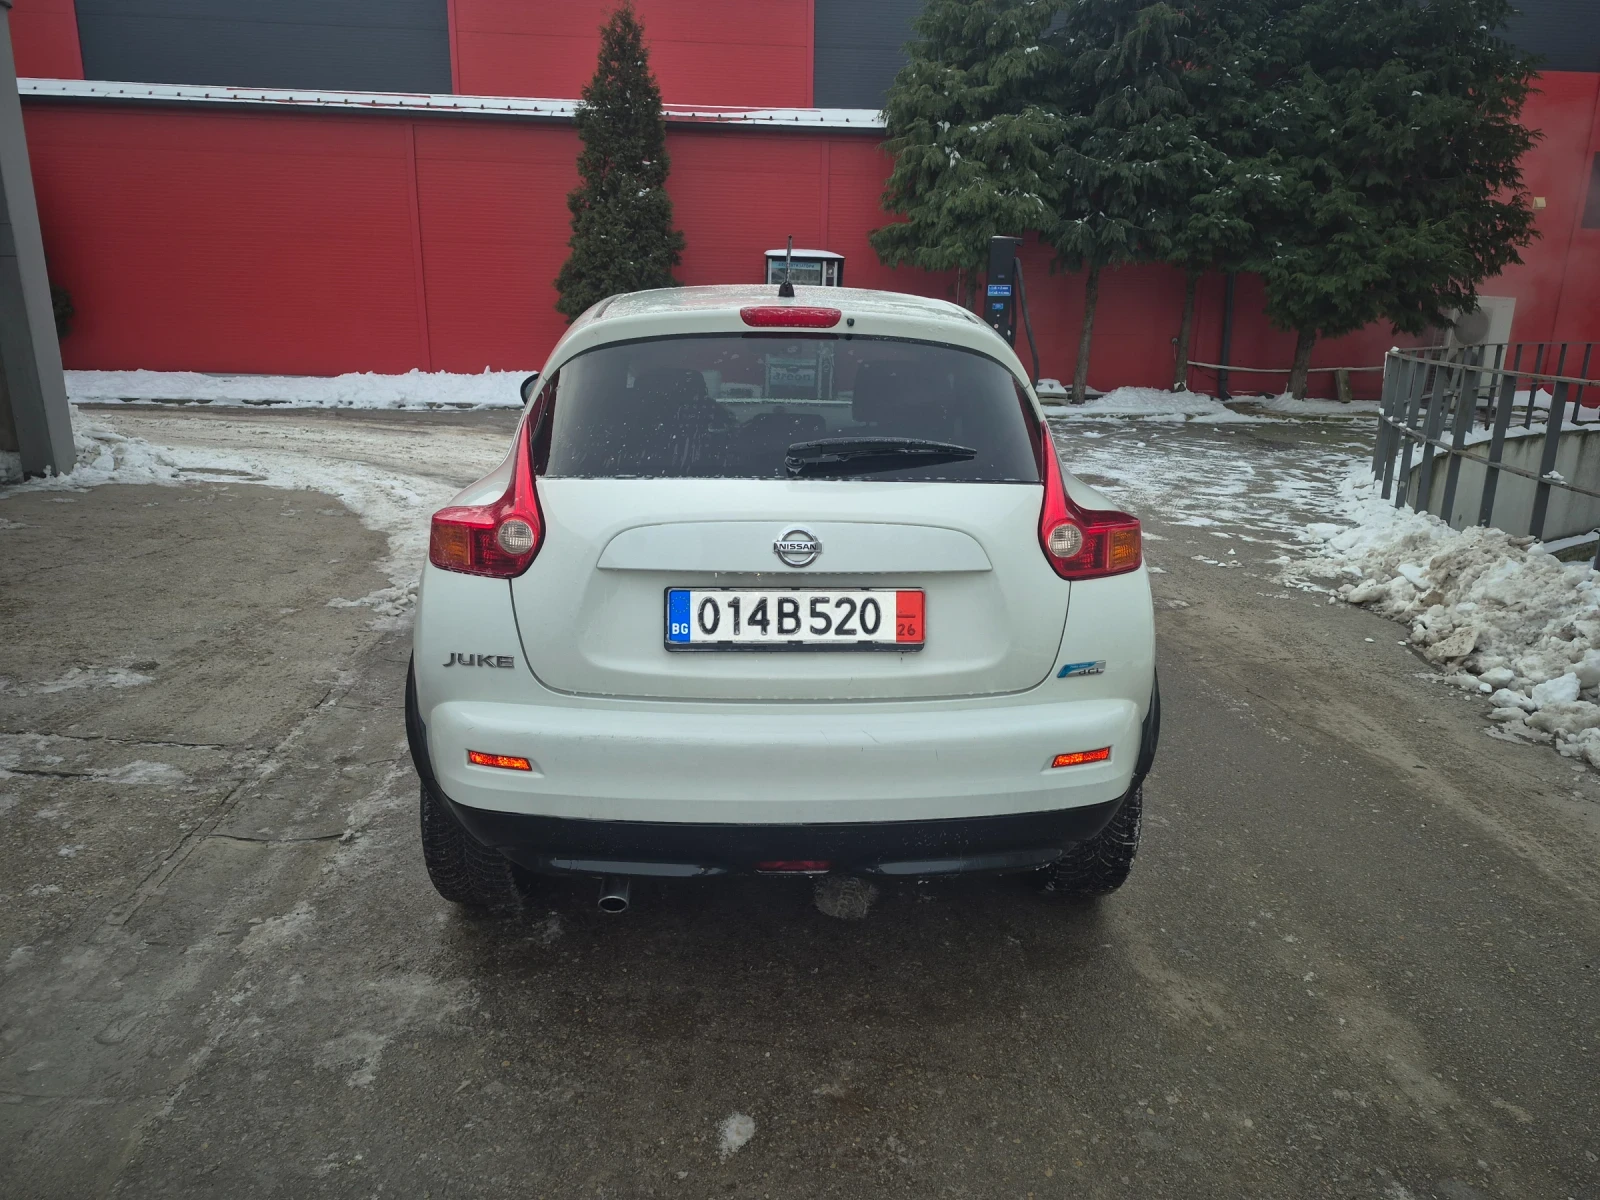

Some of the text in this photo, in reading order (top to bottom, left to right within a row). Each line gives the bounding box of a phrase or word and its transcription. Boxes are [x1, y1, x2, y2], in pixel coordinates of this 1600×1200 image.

[697, 596, 882, 636] 014B520
[671, 623, 689, 635] BG
[897, 623, 916, 636] 26
[442, 652, 515, 668] JUKE
